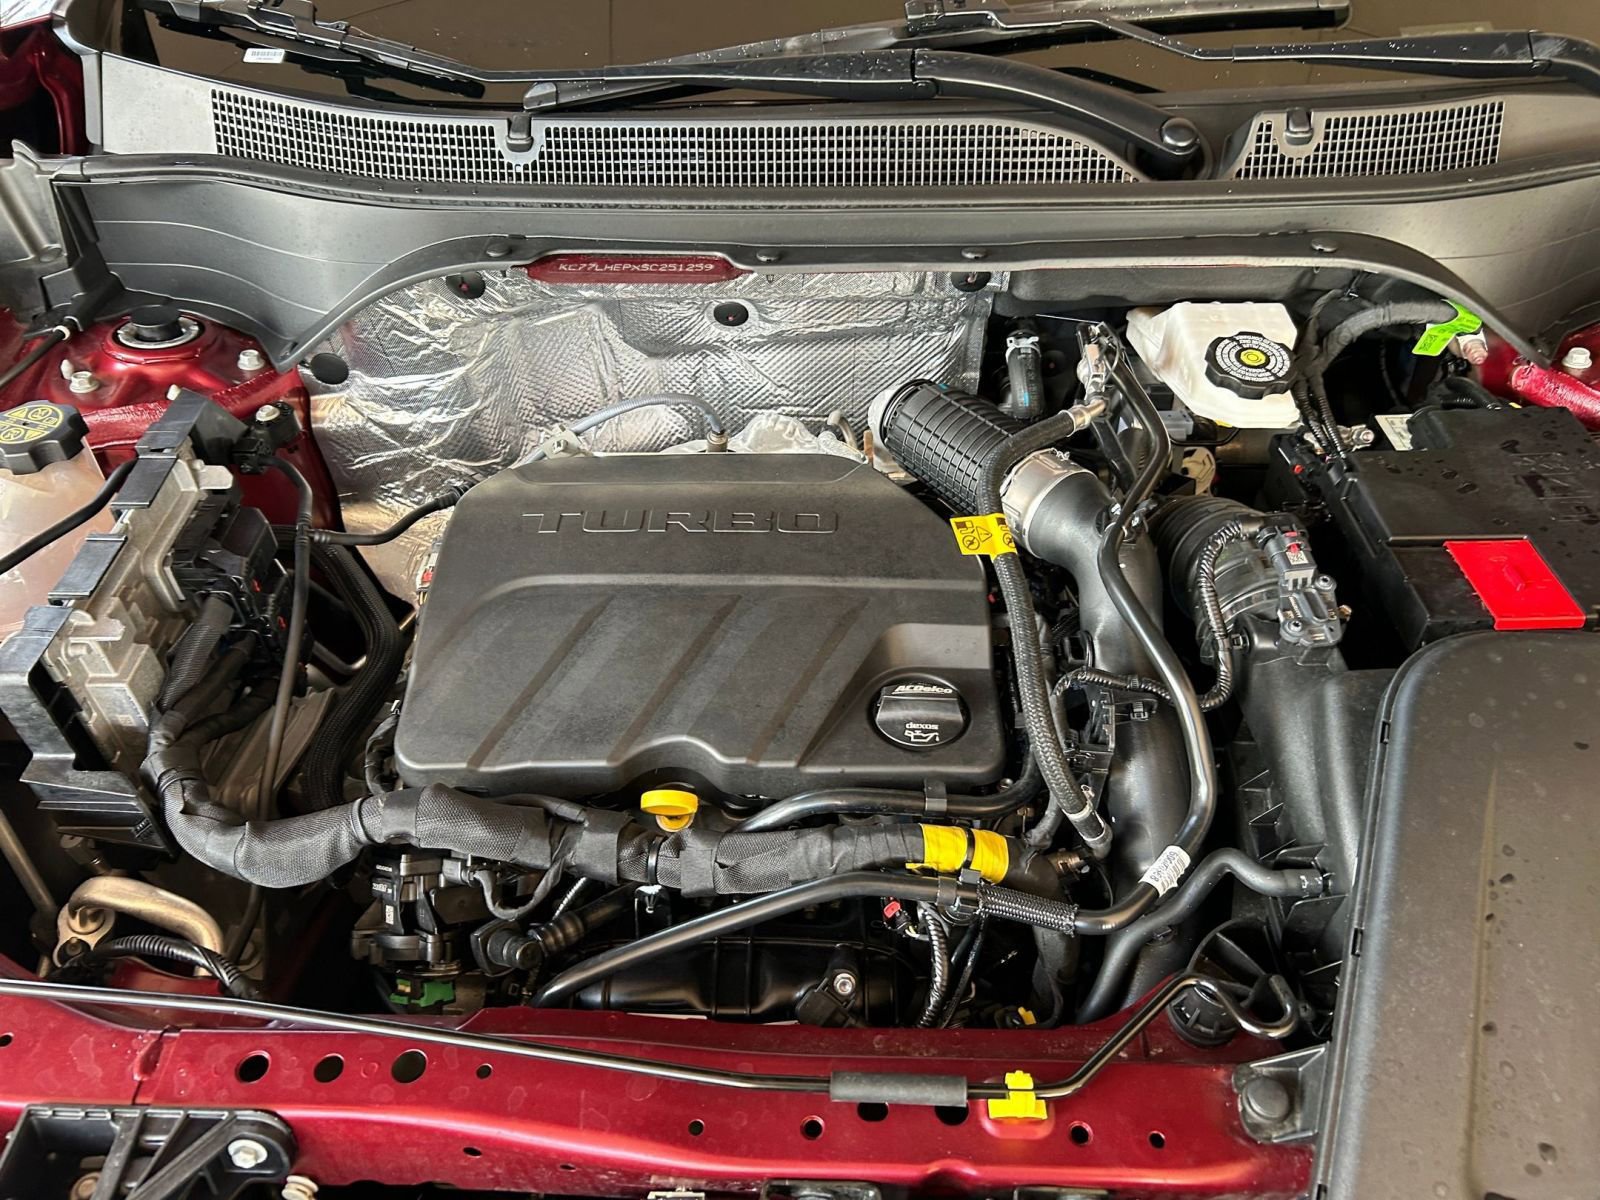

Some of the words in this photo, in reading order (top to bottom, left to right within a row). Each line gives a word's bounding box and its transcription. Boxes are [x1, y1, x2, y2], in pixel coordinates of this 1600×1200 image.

[521, 510, 839, 534] TURBO
[892, 685, 953, 695] ACDelco
[905, 721, 939, 730] dexos
